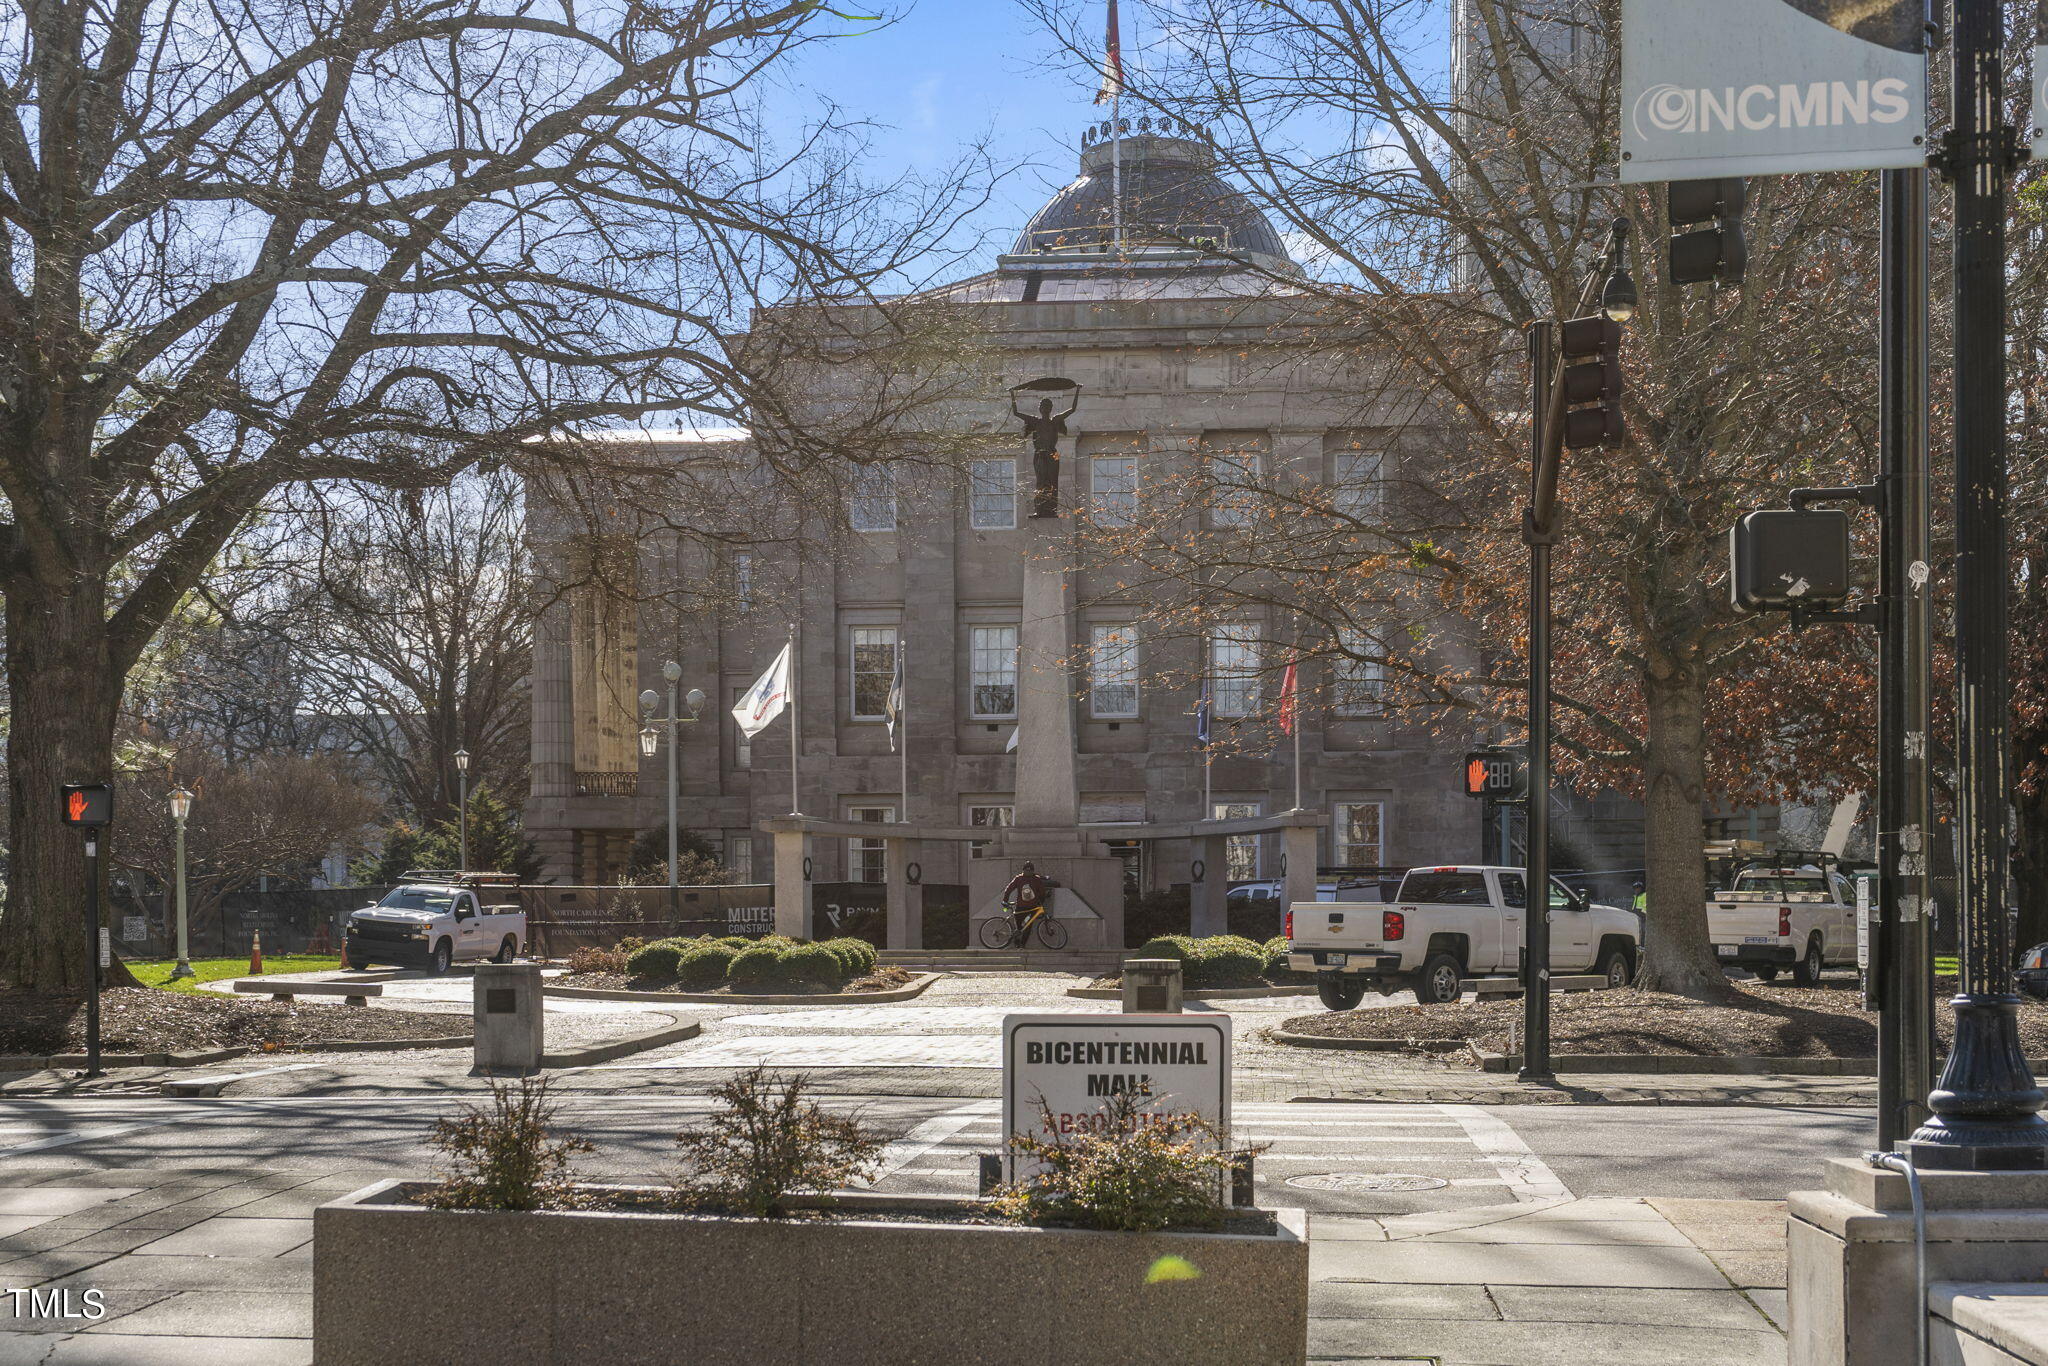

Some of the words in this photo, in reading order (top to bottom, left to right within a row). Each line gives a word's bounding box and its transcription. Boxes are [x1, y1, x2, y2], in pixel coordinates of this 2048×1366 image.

[1700, 78, 1910, 133] NCMNS
[1026, 1042, 1208, 1065] BICENTENNIAL
[1087, 1074, 1153, 1097] MALL
